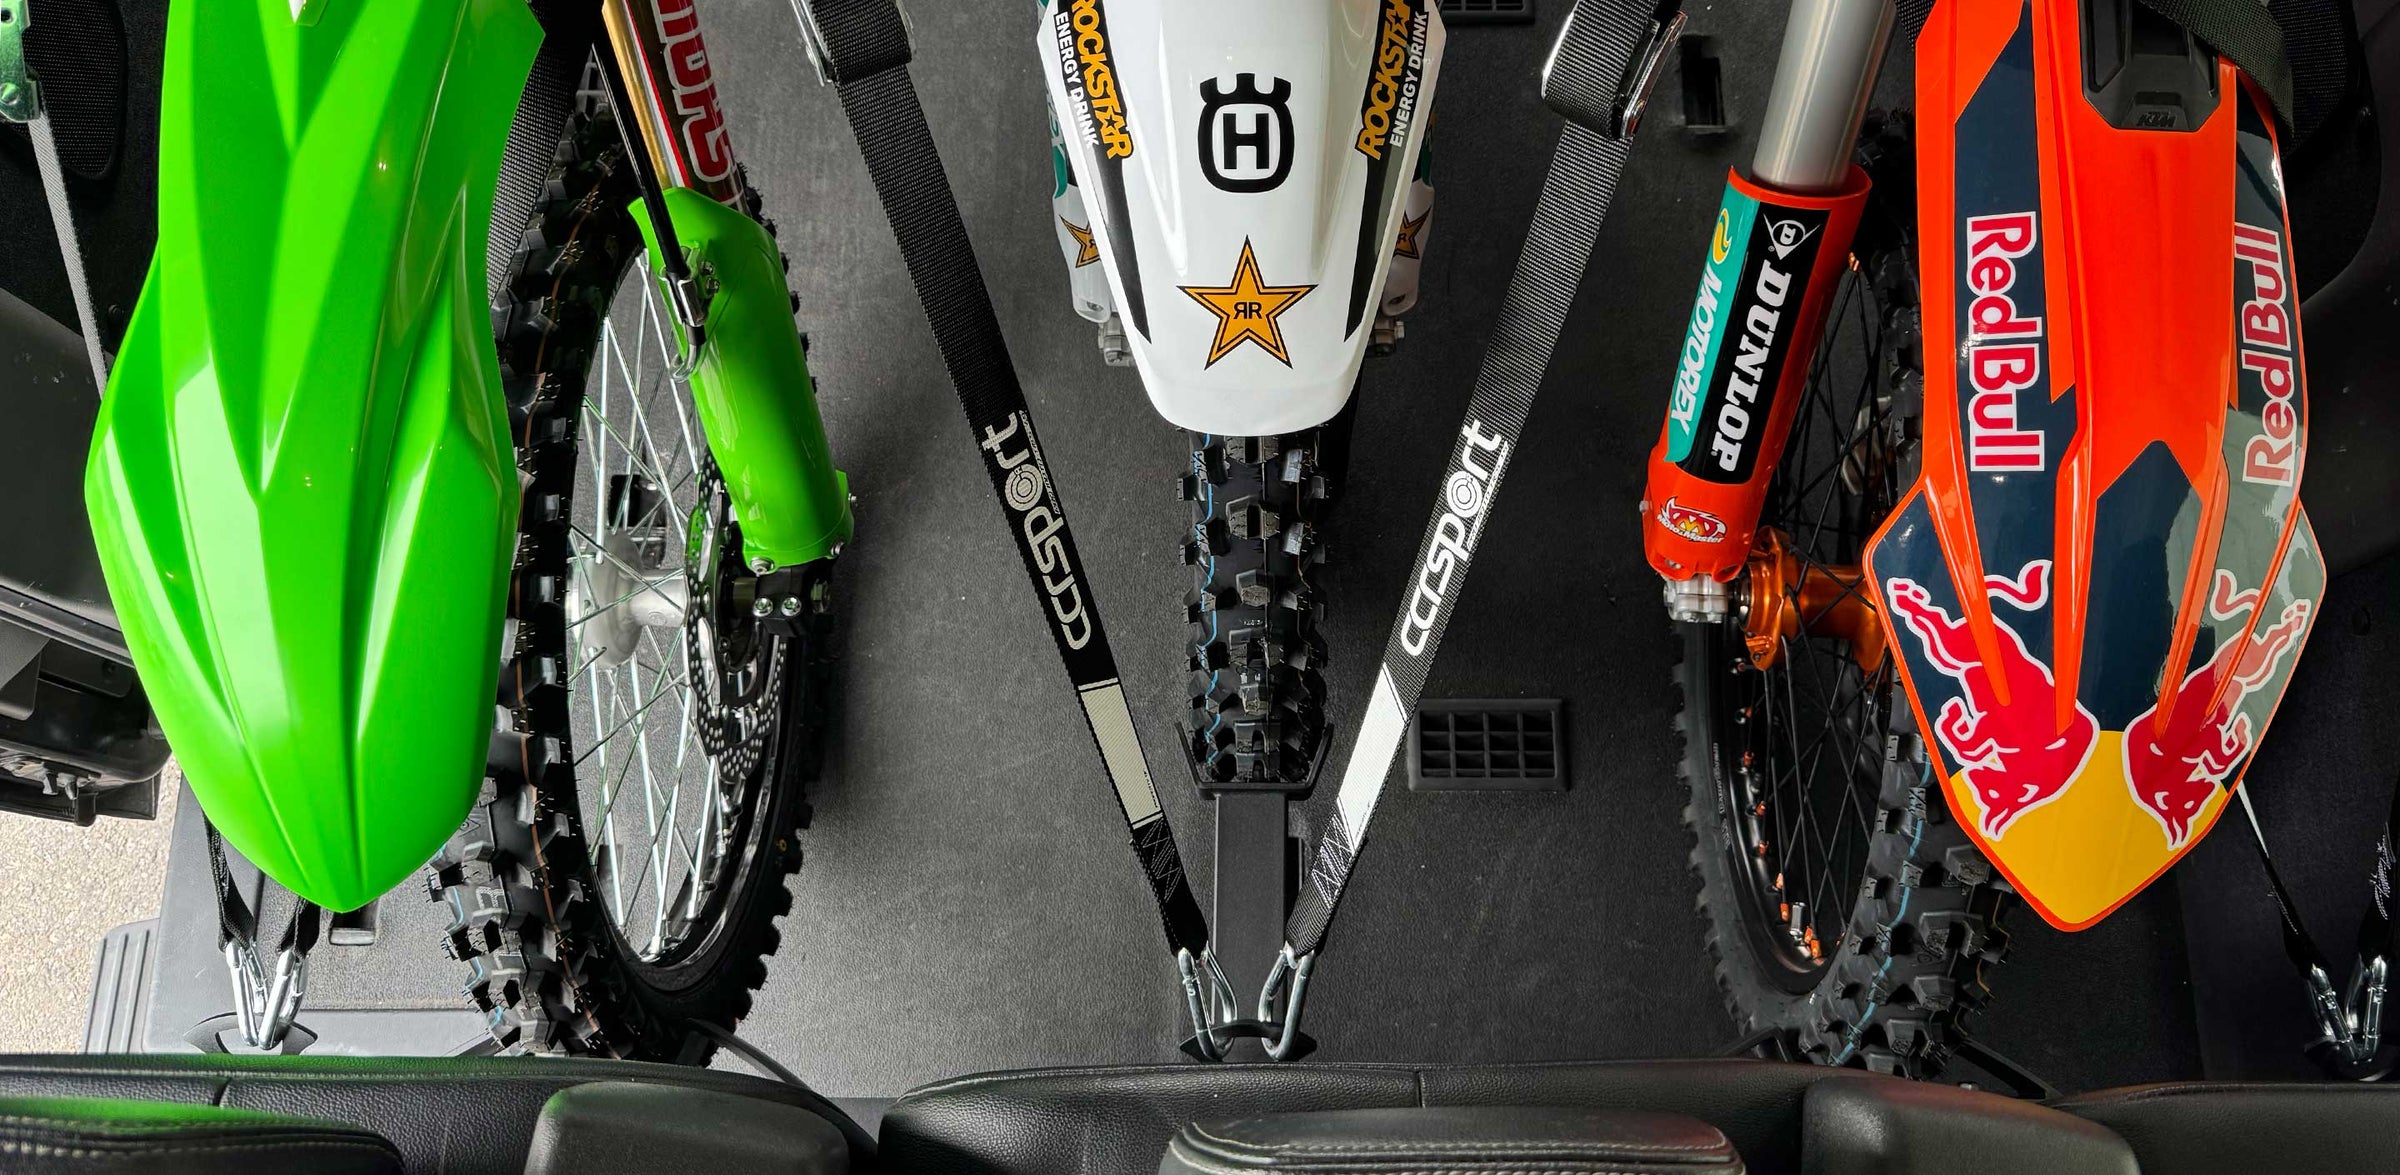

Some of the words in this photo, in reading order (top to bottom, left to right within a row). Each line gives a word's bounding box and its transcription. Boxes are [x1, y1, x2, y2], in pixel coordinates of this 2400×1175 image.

[1055, 11, 1082, 84] ENERGY
[1070, 86, 1100, 149] DRINK
[1357, 0, 1411, 160] ROCKSTA
[1390, 71, 1419, 147] ENERGY
[1411, 11, 1428, 70] DRINK
[1671, 262, 1722, 435] MOTOREX
[1711, 259, 1792, 472] DUNLOP
